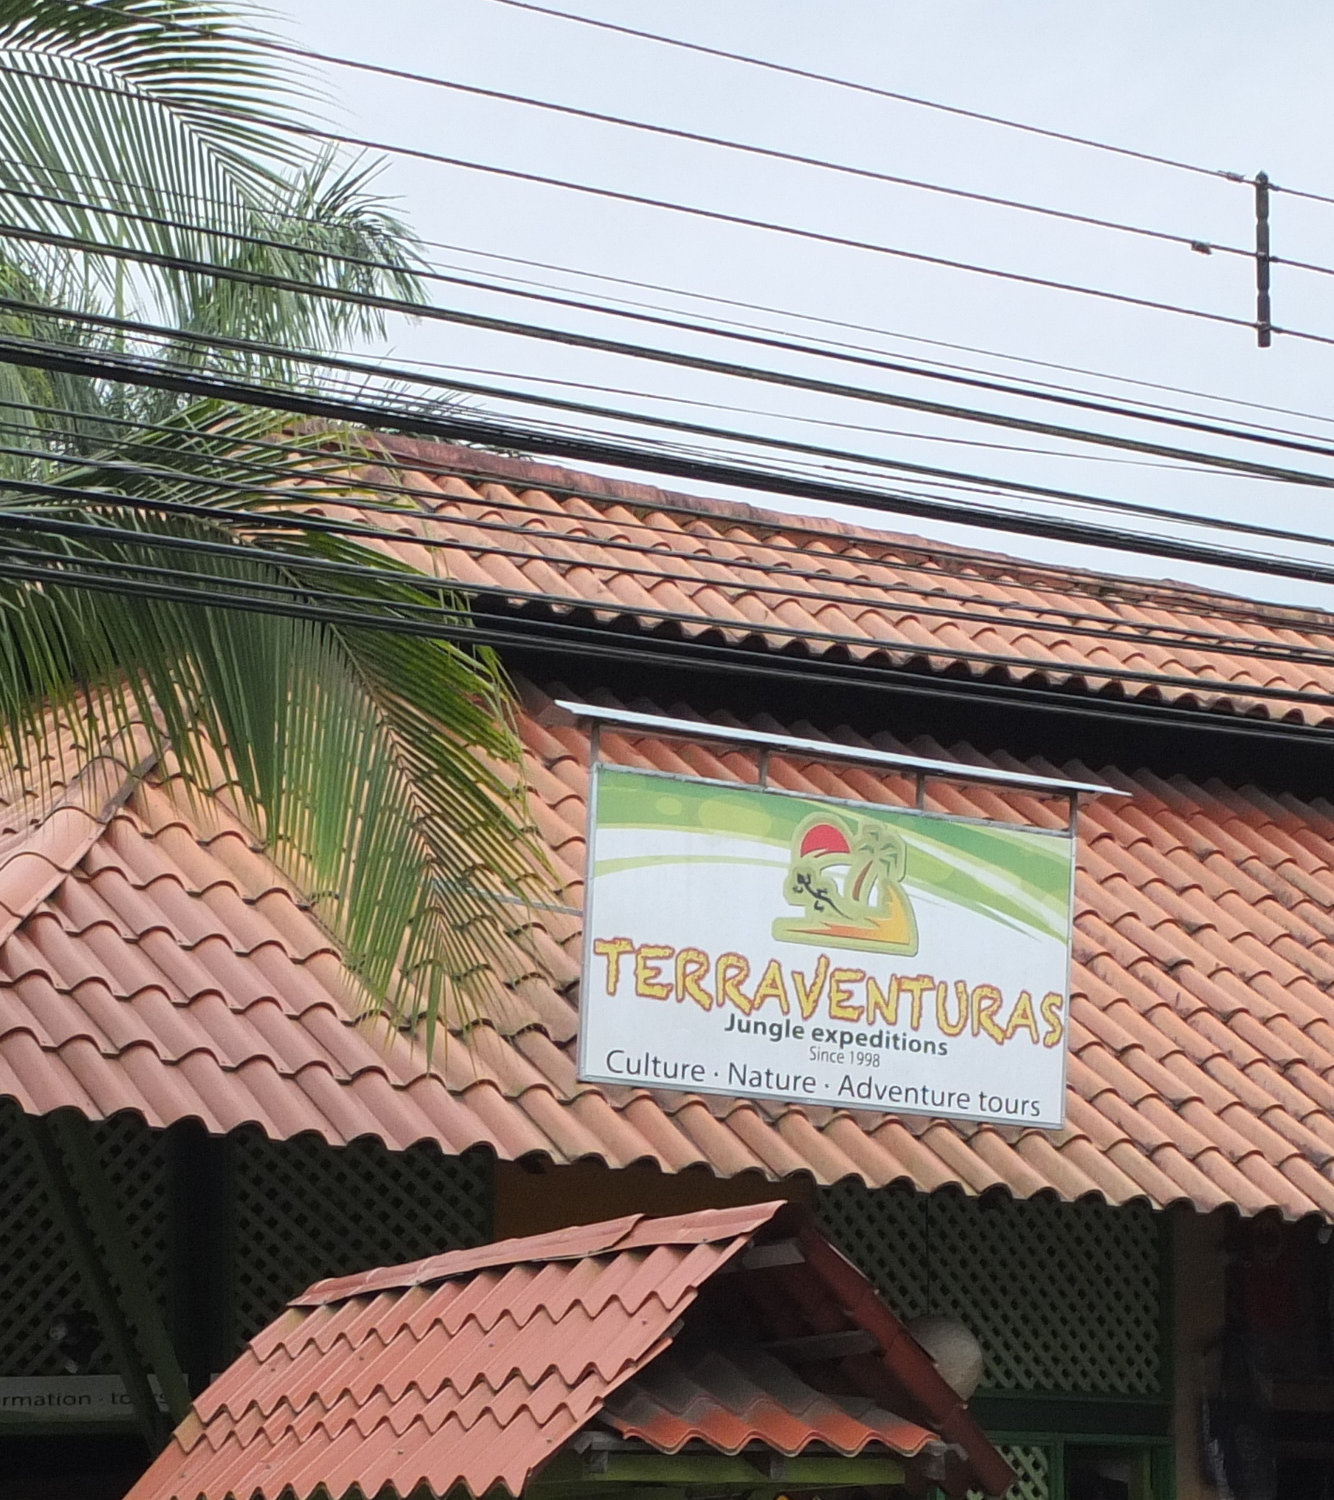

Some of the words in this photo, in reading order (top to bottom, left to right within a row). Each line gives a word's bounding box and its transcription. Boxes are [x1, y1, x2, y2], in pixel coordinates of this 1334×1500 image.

[594, 938, 1064, 1047] TERRAVENTURAS
[724, 1013, 805, 1042] Jungle
[812, 1024, 948, 1056] expeditions
[809, 1046, 845, 1064] Since
[849, 1049, 880, 1068] 1998
[605, 1049, 706, 1082] Culture
[728, 1061, 816, 1094] Nature
[838, 1073, 971, 1111] Adventure
[979, 1093, 1041, 1118] tours
